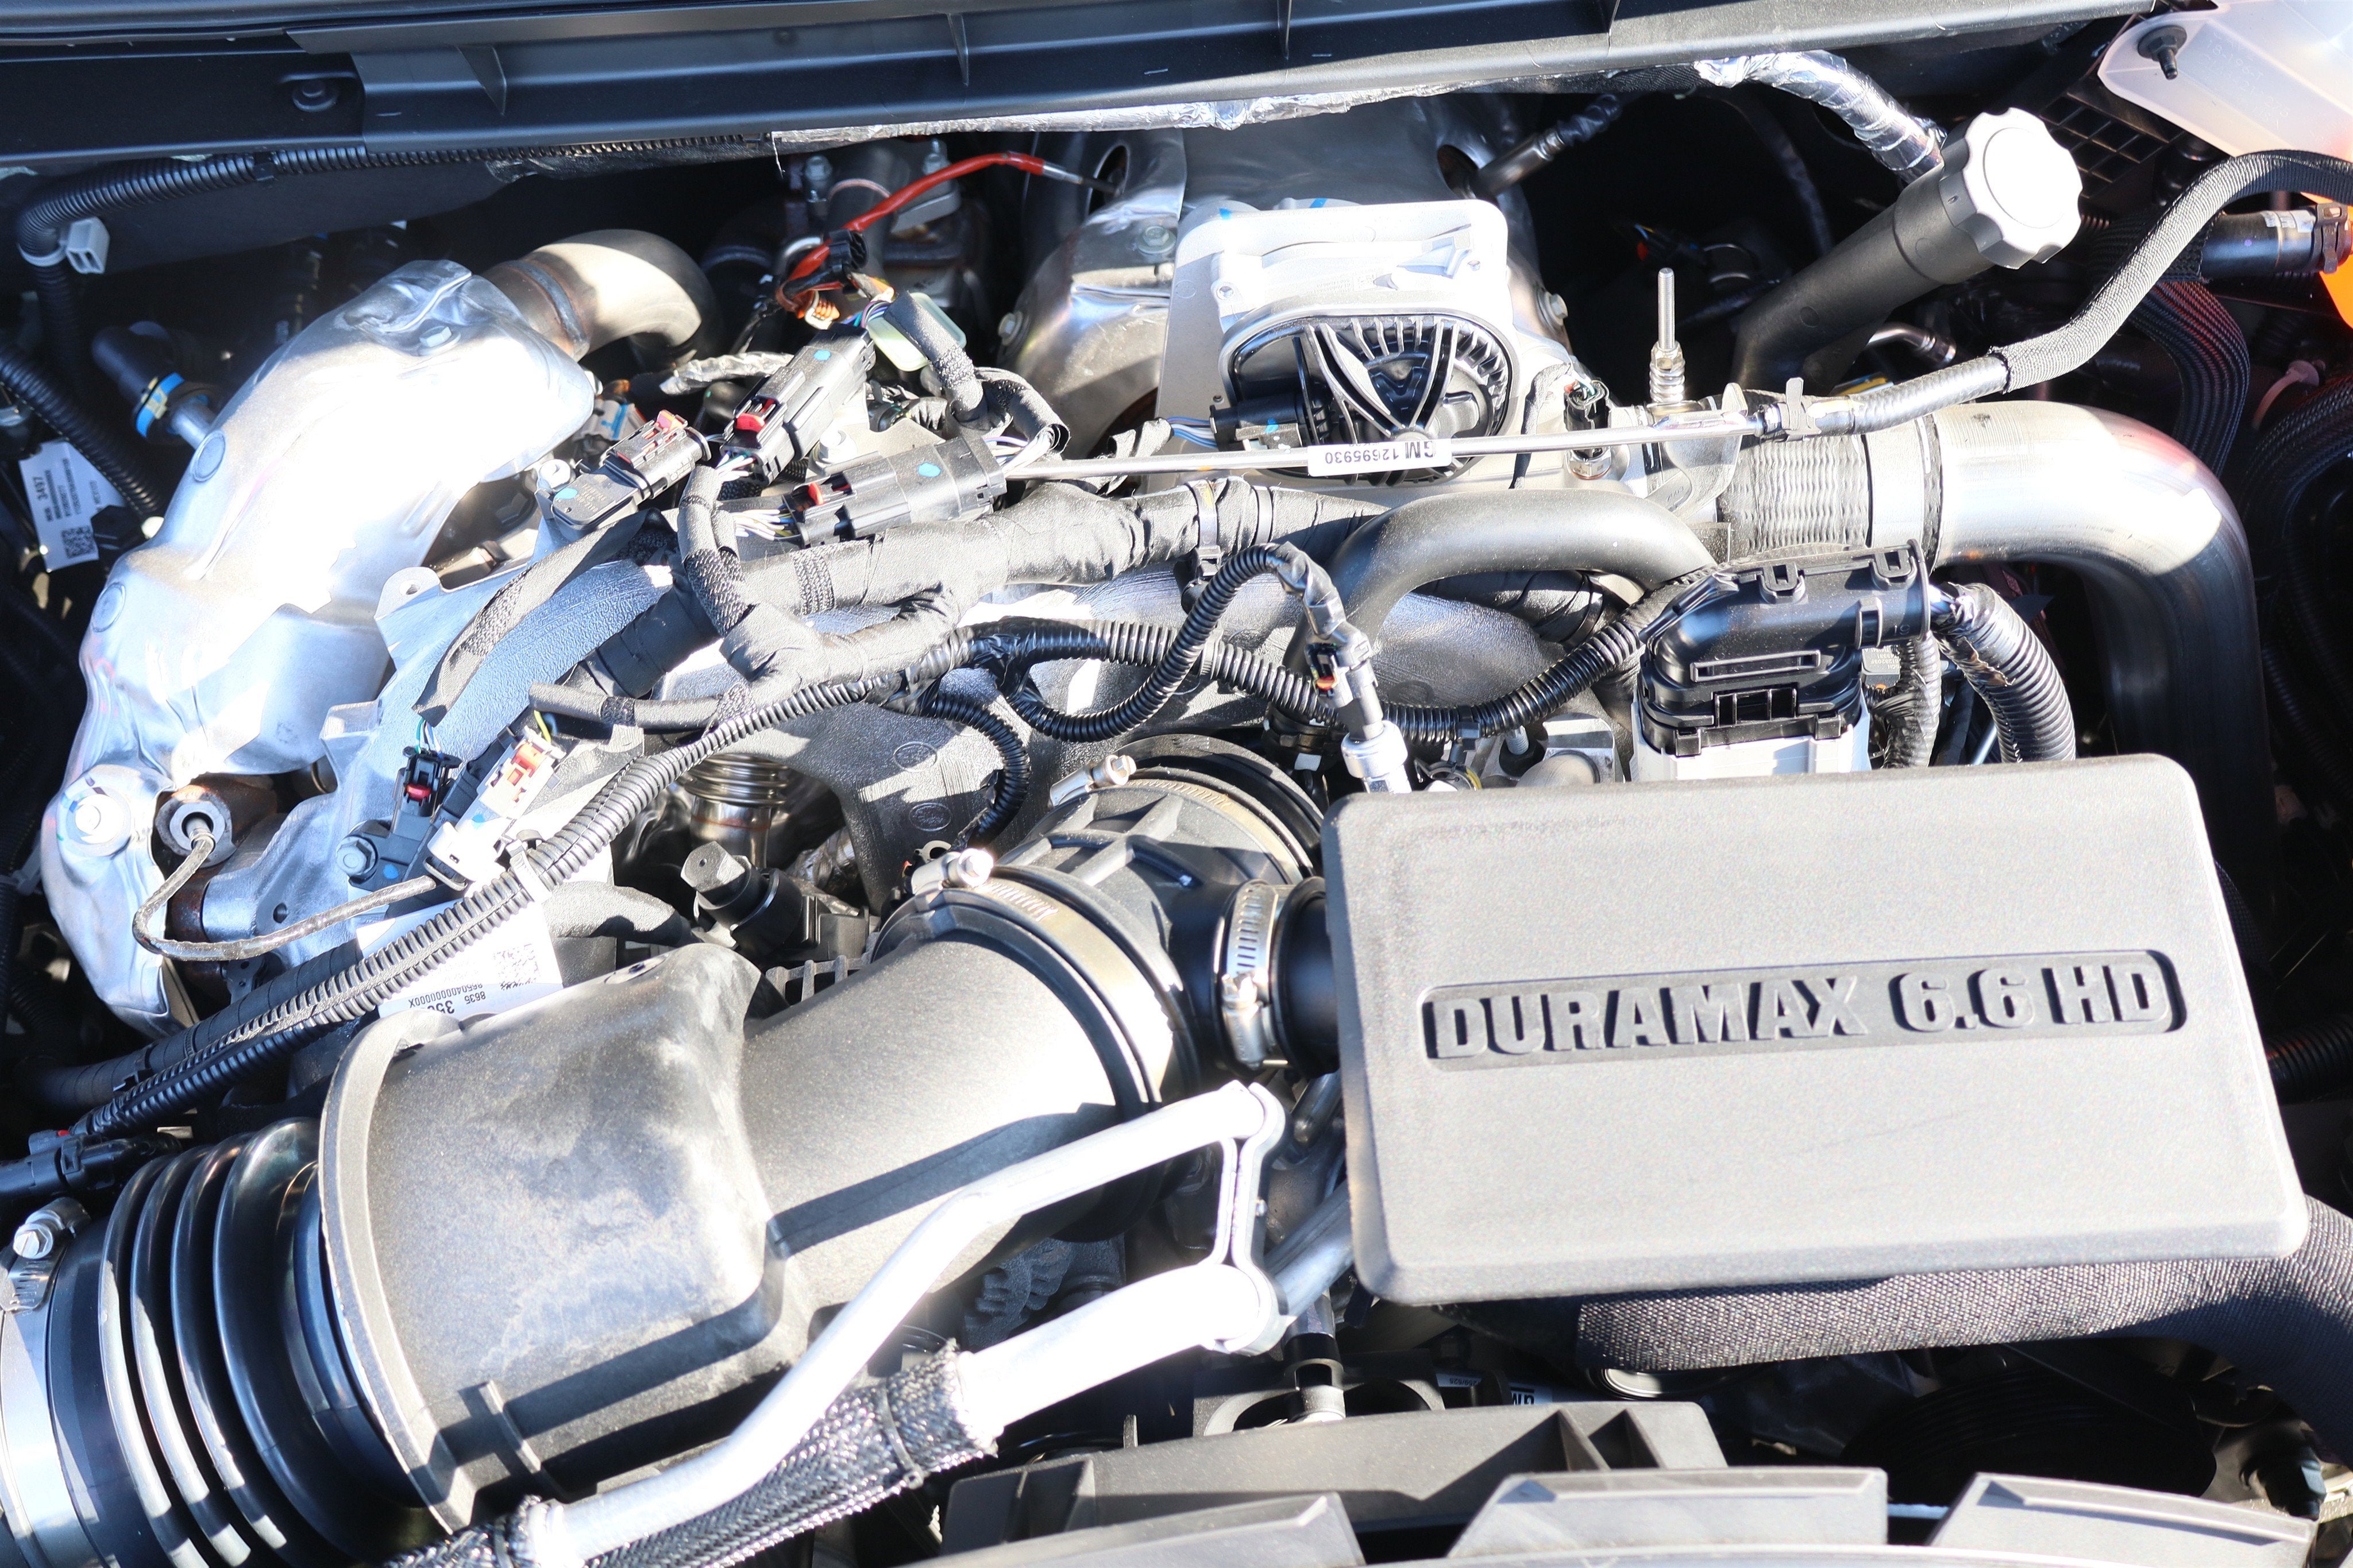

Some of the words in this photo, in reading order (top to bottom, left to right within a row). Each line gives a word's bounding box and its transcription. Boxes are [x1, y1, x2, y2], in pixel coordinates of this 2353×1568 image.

[1325, 448, 1399, 464] 12695930
[1405, 441, 1436, 459] GM
[464, 991, 486, 1005] 8635
[1425, 976, 1869, 1059] DURAMAX
